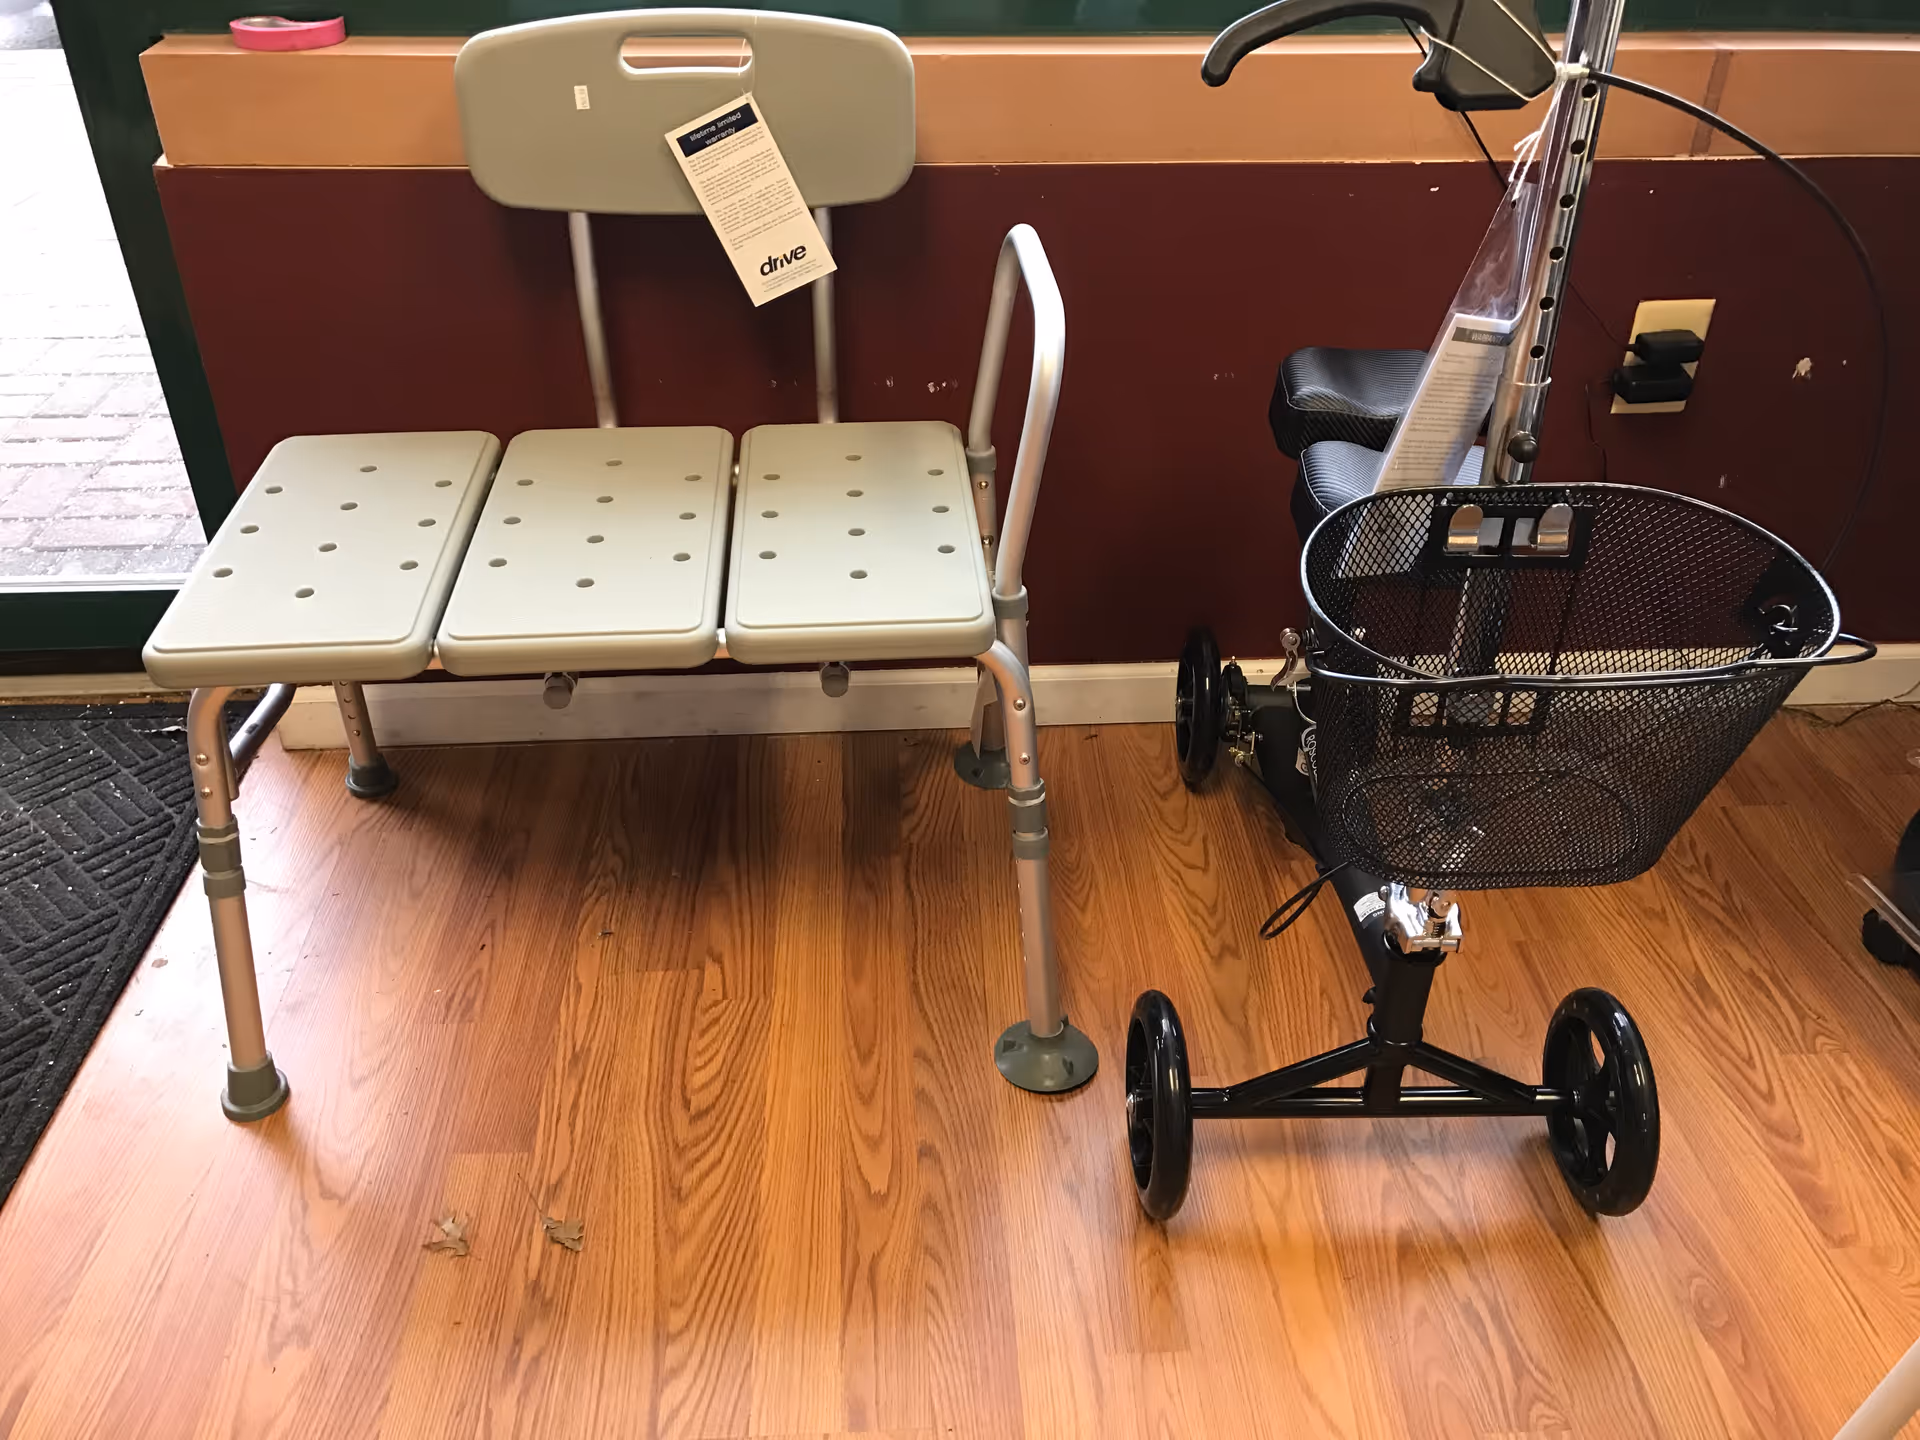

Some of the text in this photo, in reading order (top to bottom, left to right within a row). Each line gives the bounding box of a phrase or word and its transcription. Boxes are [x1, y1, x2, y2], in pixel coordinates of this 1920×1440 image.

[690, 113, 741, 142] lifetime limited
[705, 127, 735, 144] warranty
[760, 244, 807, 276] drive
